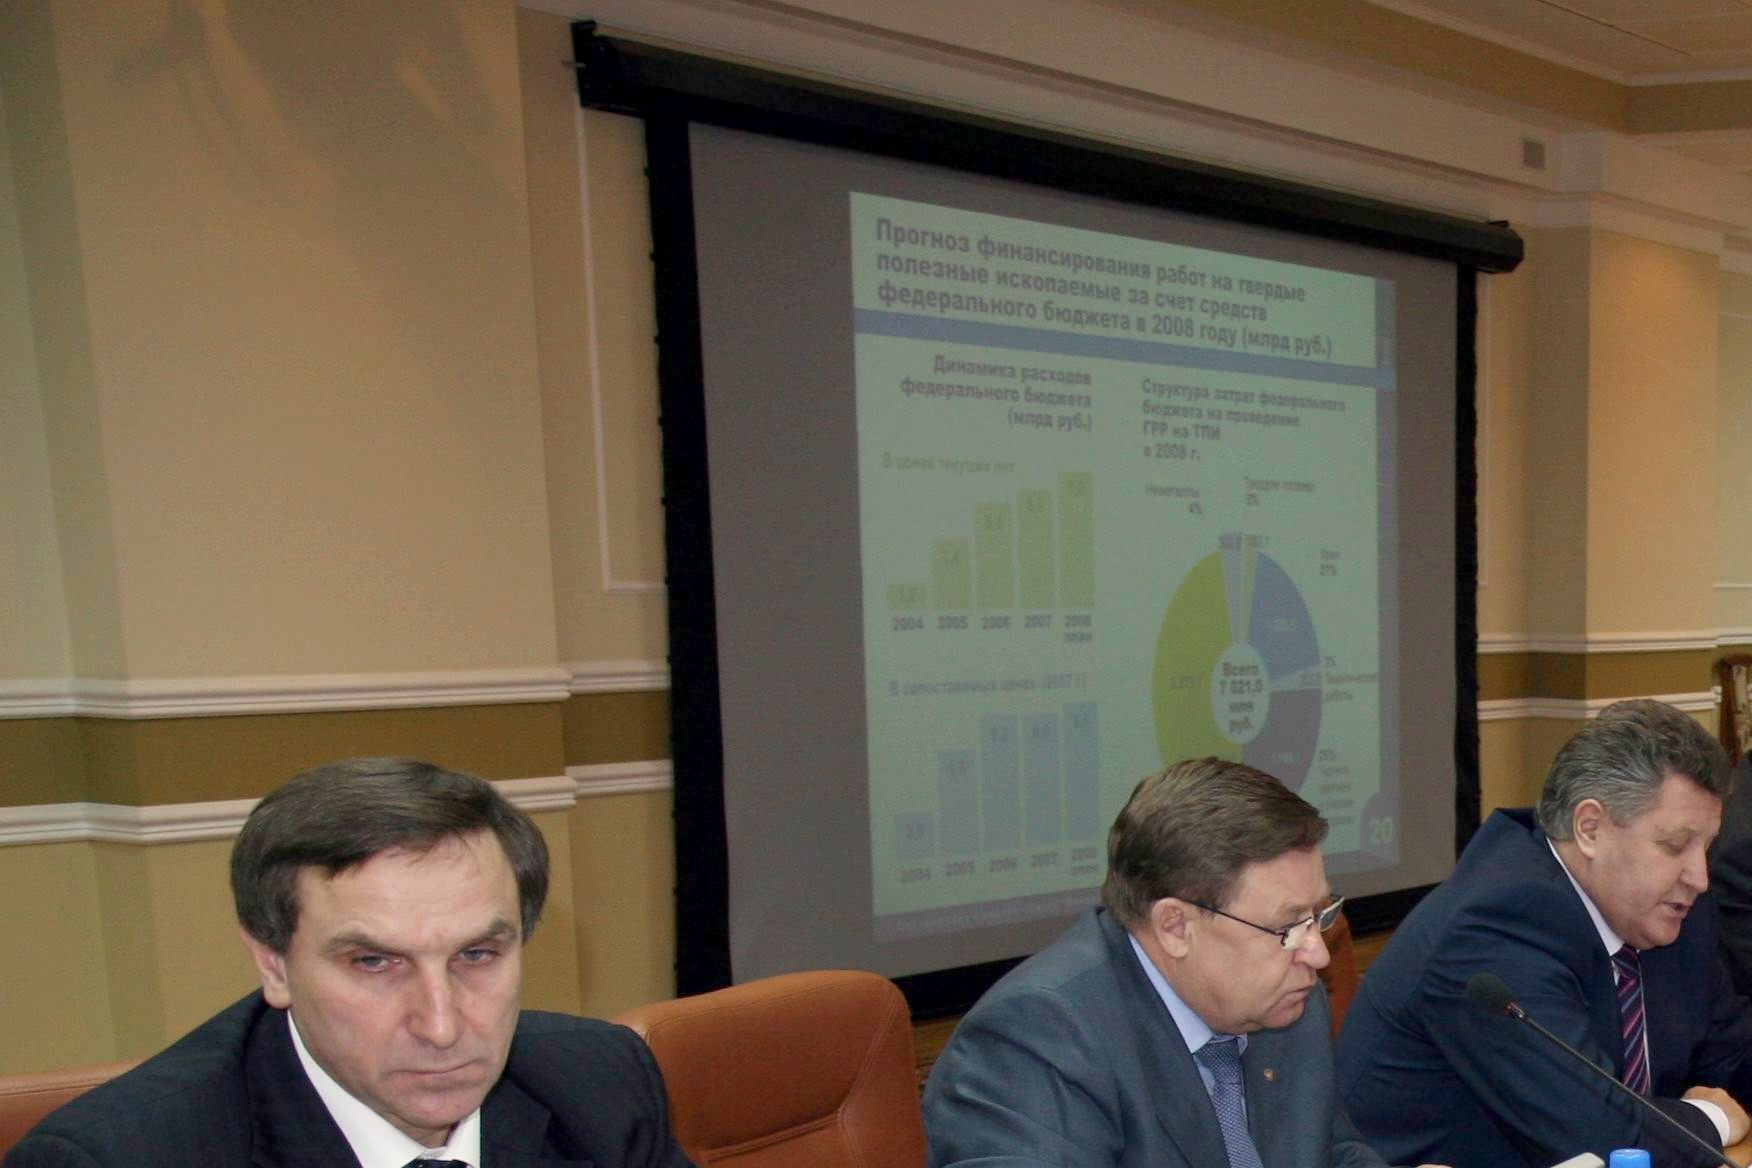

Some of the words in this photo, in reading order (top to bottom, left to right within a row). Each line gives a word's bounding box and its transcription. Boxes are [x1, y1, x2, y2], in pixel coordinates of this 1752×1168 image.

[876, 217, 970, 252] Прогноз
[977, 234, 1150, 279] финансирования
[1156, 264, 1206, 287] работ
[1211, 273, 1232, 291] на
[1238, 278, 1305, 302] твердые
[877, 253, 989, 284] полезные
[996, 269, 1121, 301] ископаемые
[1127, 287, 1149, 304] за
[1154, 291, 1195, 311] счет
[1200, 299, 1267, 322] средств
[878, 279, 1037, 319] федерального
[1043, 300, 1130, 330] бюджета
[1136, 318, 1146, 332] в
[1152, 313, 1194, 338] 2008
[1200, 325, 1237, 348] году
[1242, 326, 1291, 353] (млрд
[1295, 335, 1332, 358] руб.)
[933, 354, 1015, 379] Динамика
[1020, 367, 1092, 386] расходов
[900, 376, 1019, 401] федерального
[1024, 386, 1092, 408] бюджета
[1142, 378, 1209, 400] Структура
[1008, 407, 1053, 429] (млрд
[1143, 420, 1168, 437] ГРР
[1172, 425, 1189, 439] на
[1191, 424, 1221, 440] ТПИ
